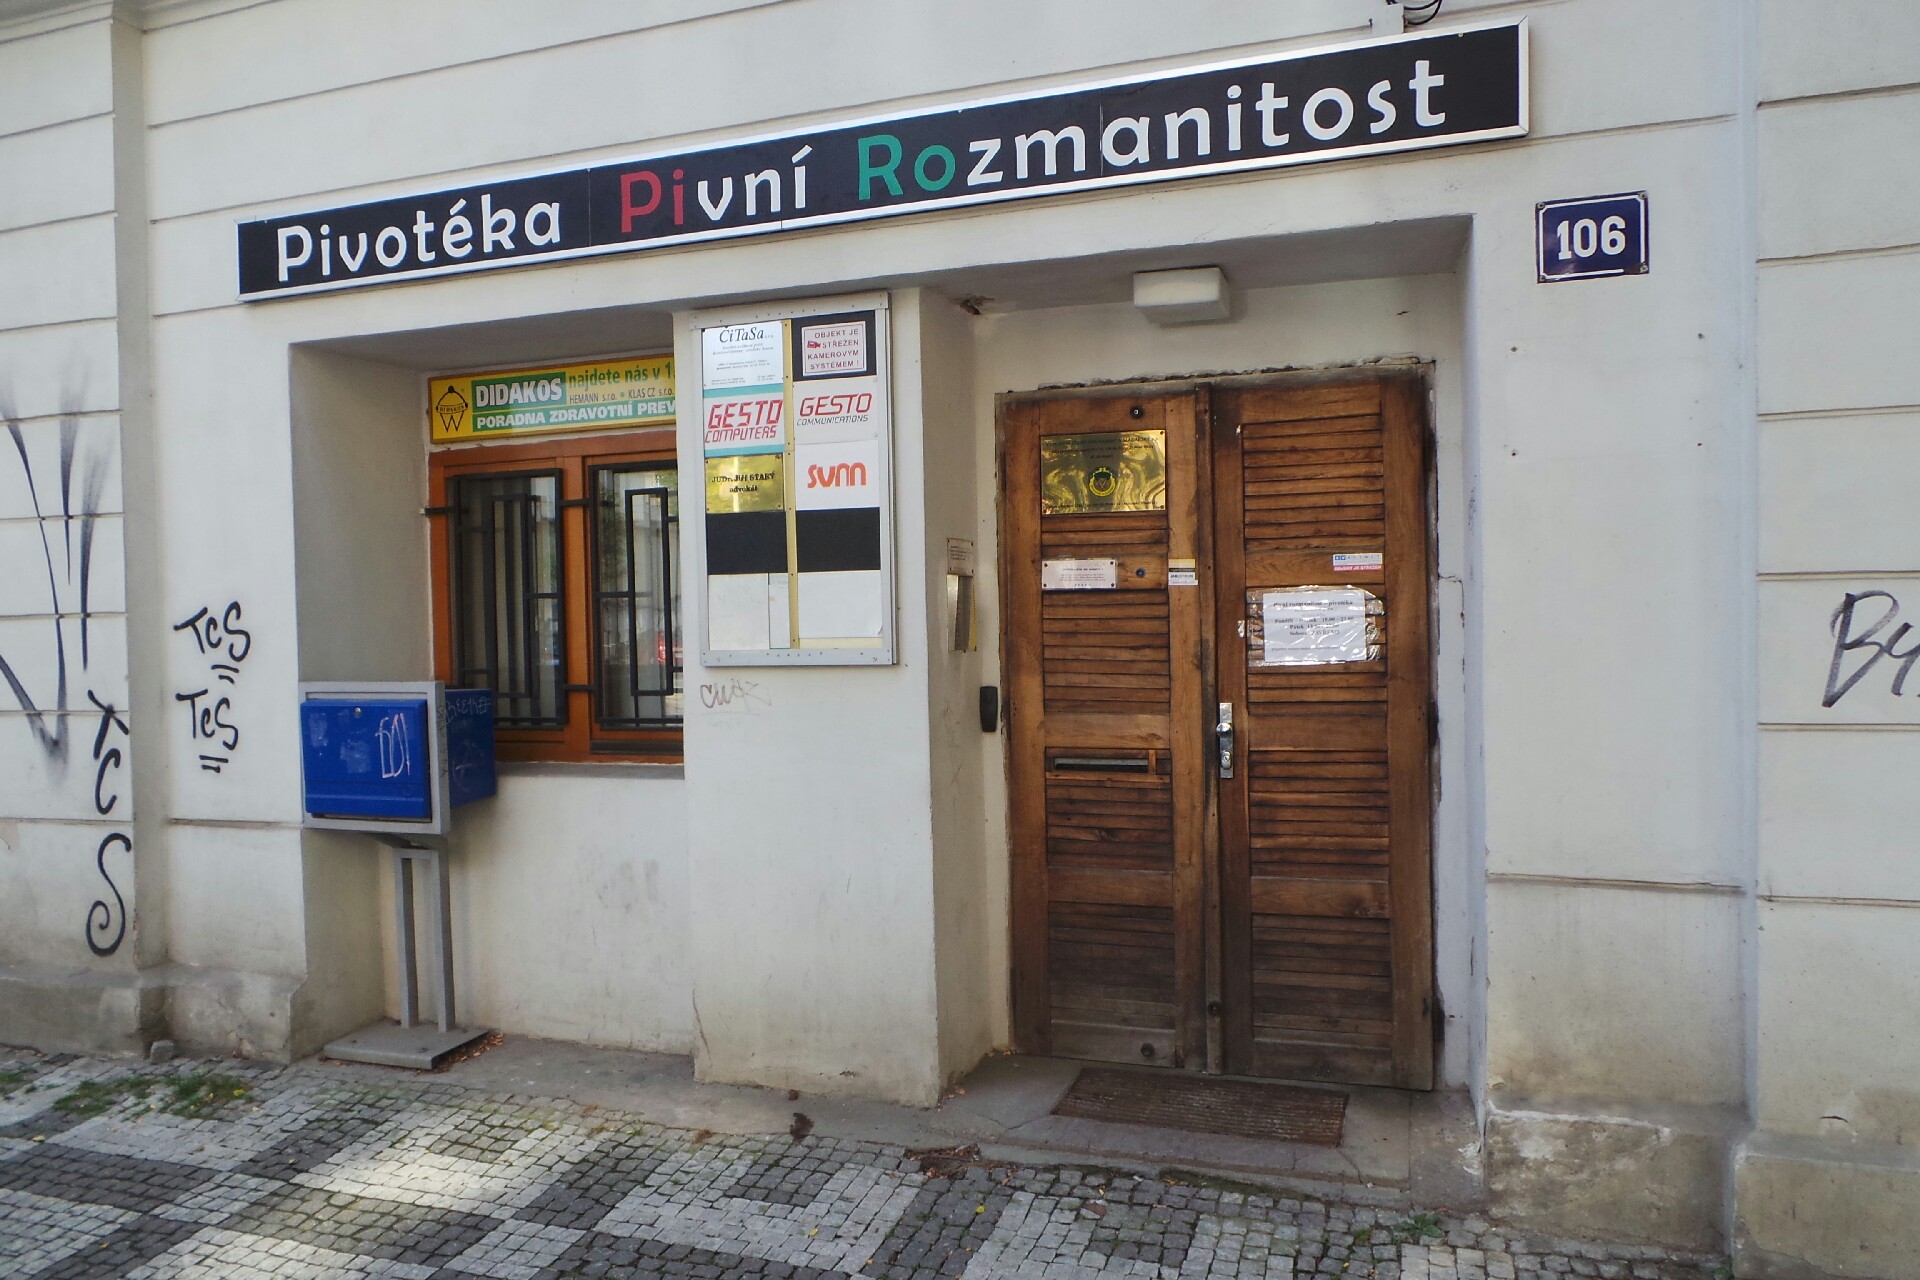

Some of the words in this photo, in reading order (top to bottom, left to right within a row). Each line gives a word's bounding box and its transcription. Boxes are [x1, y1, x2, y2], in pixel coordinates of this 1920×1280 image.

[277, 193, 560, 282] Pivotéka
[619, 145, 813, 233] Pivní
[857, 60, 1447, 200] Rozmanitost
[1557, 215, 1626, 260] 106
[719, 326, 764, 343] CiTaSa
[814, 329, 847, 339] OBJEKT
[849, 328, 859, 336] JE
[822, 339, 859, 349] STŘEŽEN
[568, 368, 620, 392] najdete
[624, 365, 649, 383] nás
[652, 367, 661, 380] v
[475, 378, 563, 408] DIDAKOS
[569, 392, 599, 405] HEMANN
[628, 387, 646, 399] KLAS
[647, 387, 656, 398] CZ
[477, 412, 546, 429] PORADNA
[549, 401, 633, 423] ZDRAVOTNÍ
[707, 399, 783, 430] GESTO
[799, 392, 873, 417] GESTO
[796, 414, 869, 426] COMMUNICATIONS
[704, 424, 778, 444] COMPUTERS
[729, 484, 759, 493] advokát
